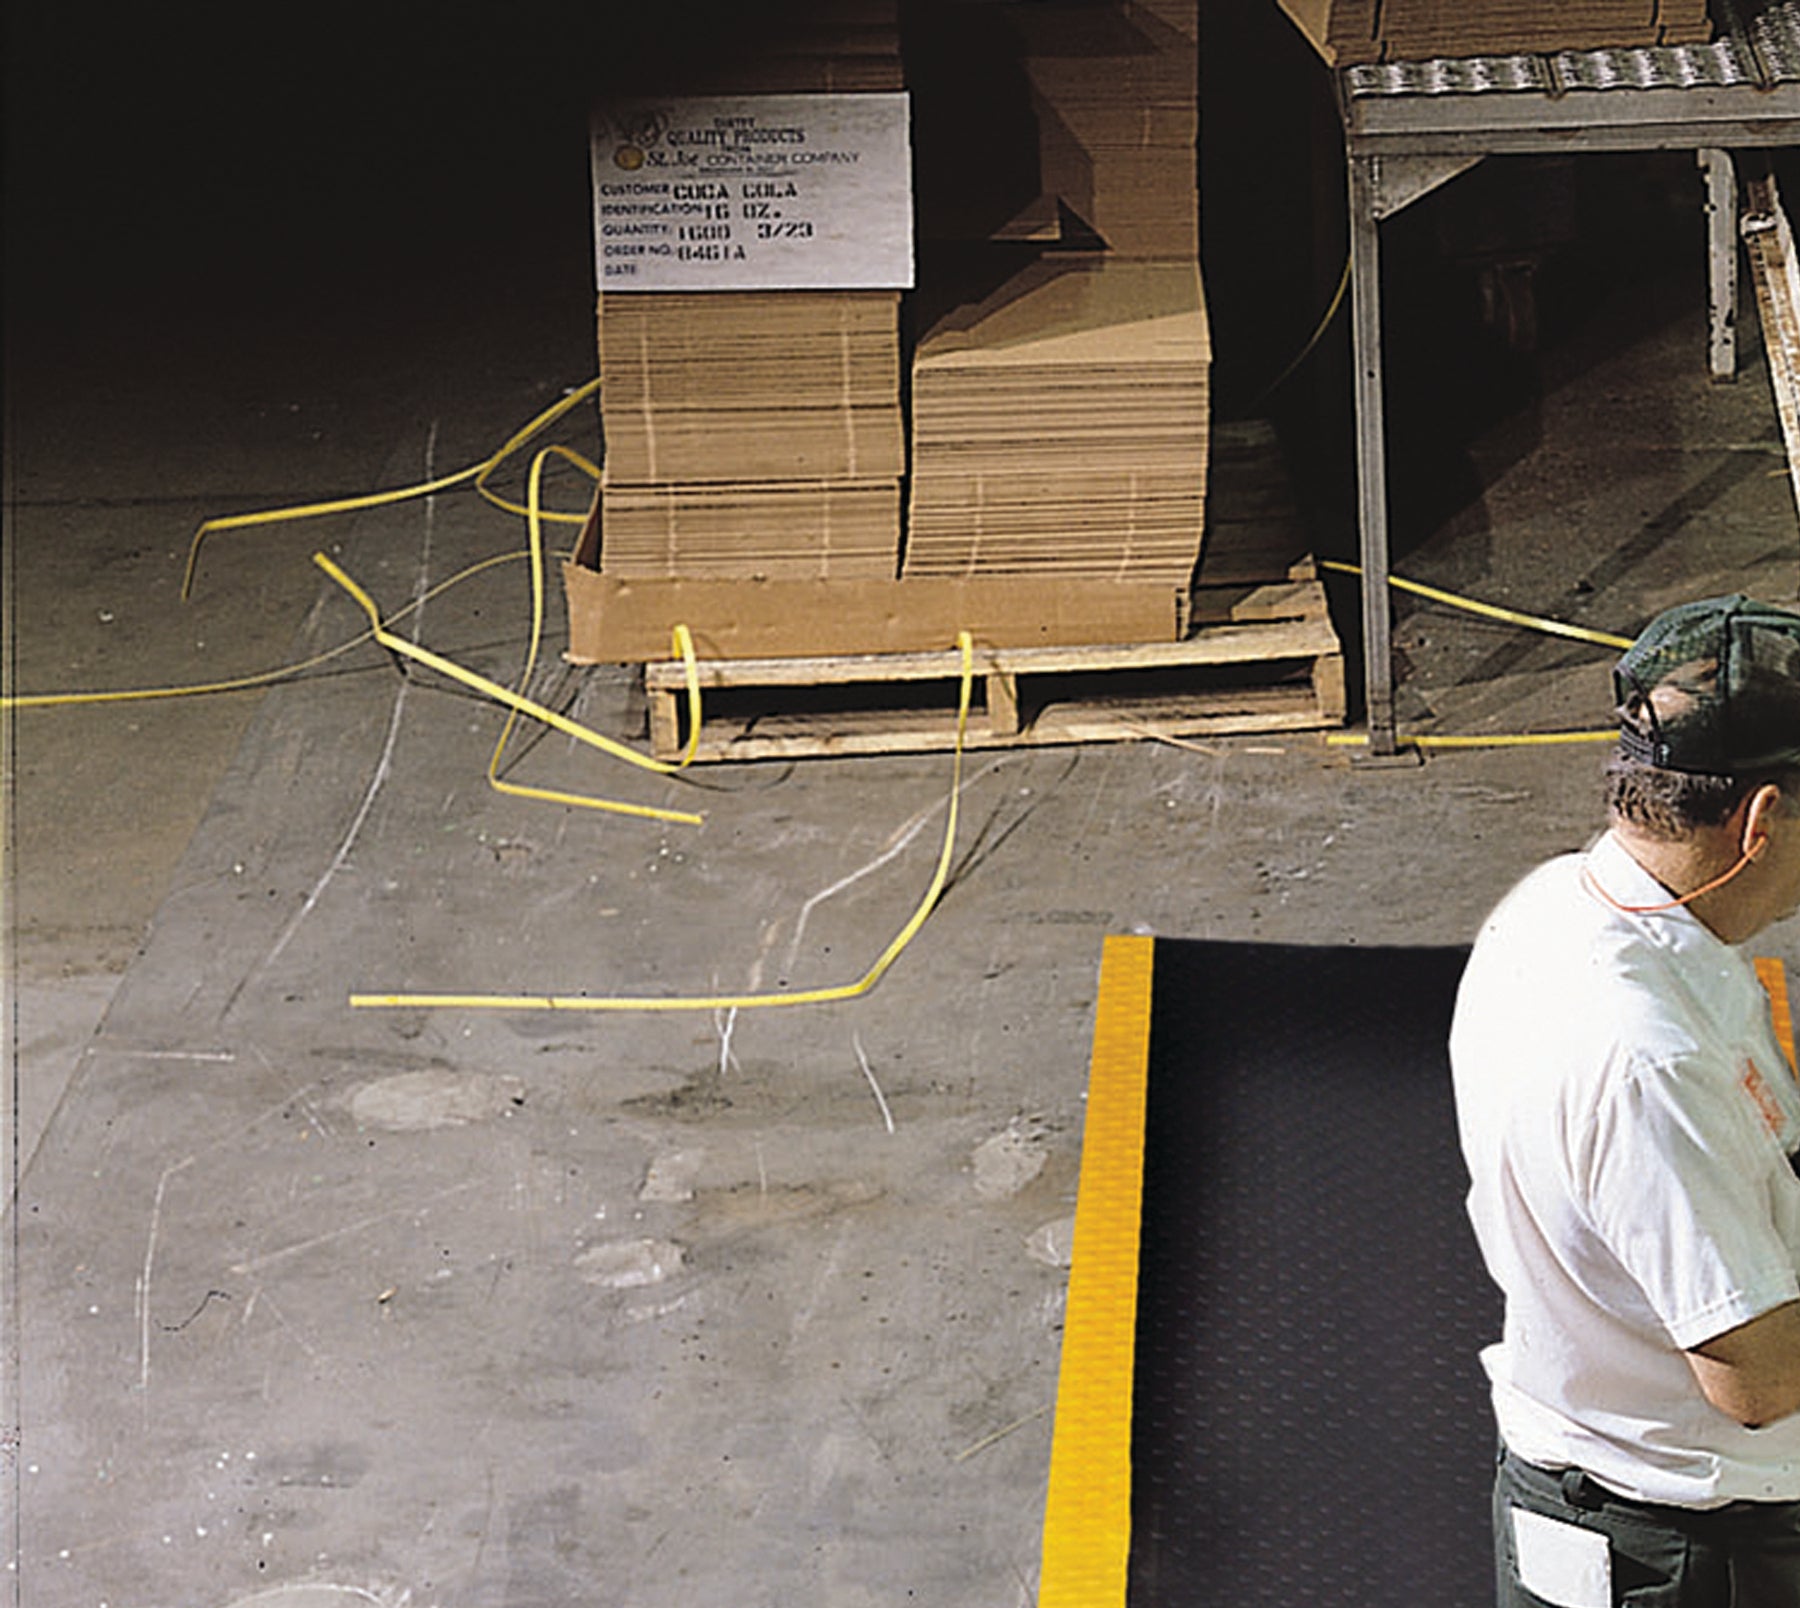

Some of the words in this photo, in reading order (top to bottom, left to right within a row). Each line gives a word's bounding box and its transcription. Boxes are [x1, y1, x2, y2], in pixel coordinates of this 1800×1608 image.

[667, 130, 727, 147] QUALITY
[734, 128, 805, 144] PRODUCTS
[707, 153, 788, 167] CONTAINER
[791, 151, 860, 165] COMPANY
[673, 183, 729, 200] COCA
[742, 182, 798, 199] COLA
[757, 222, 814, 239] 3/23
[604, 244, 646, 257] ORDER
